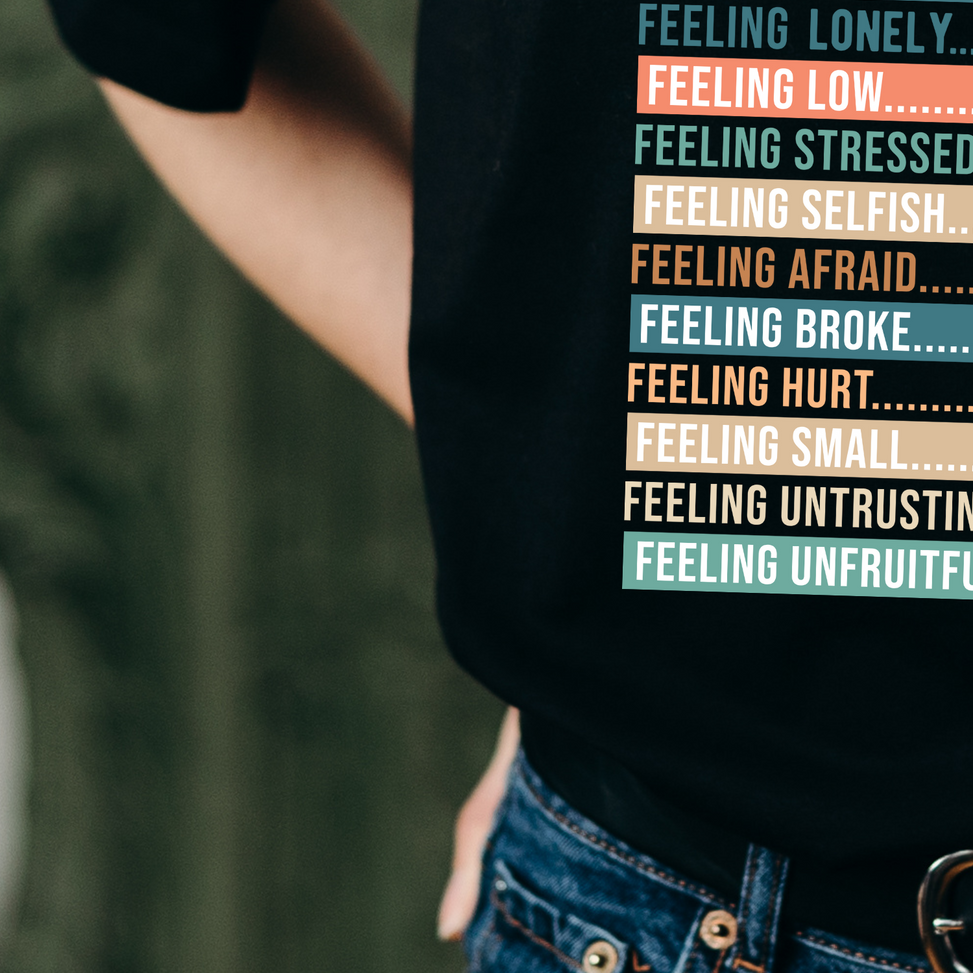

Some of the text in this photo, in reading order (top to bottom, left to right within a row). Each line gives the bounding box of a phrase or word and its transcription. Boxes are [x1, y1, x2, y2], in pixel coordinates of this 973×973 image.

[638, 3, 788, 50] FEELING
[648, 64, 794, 110] FEELING
[634, 123, 781, 170] FEELING
[644, 184, 789, 229] FEELING
[631, 243, 776, 289] FEELING
[640, 303, 782, 348] FEELING
[627, 362, 769, 407] FEELING
[636, 421, 779, 466] FEELING
[623, 480, 767, 526] FEELING
[636, 540, 778, 585] FEELING
